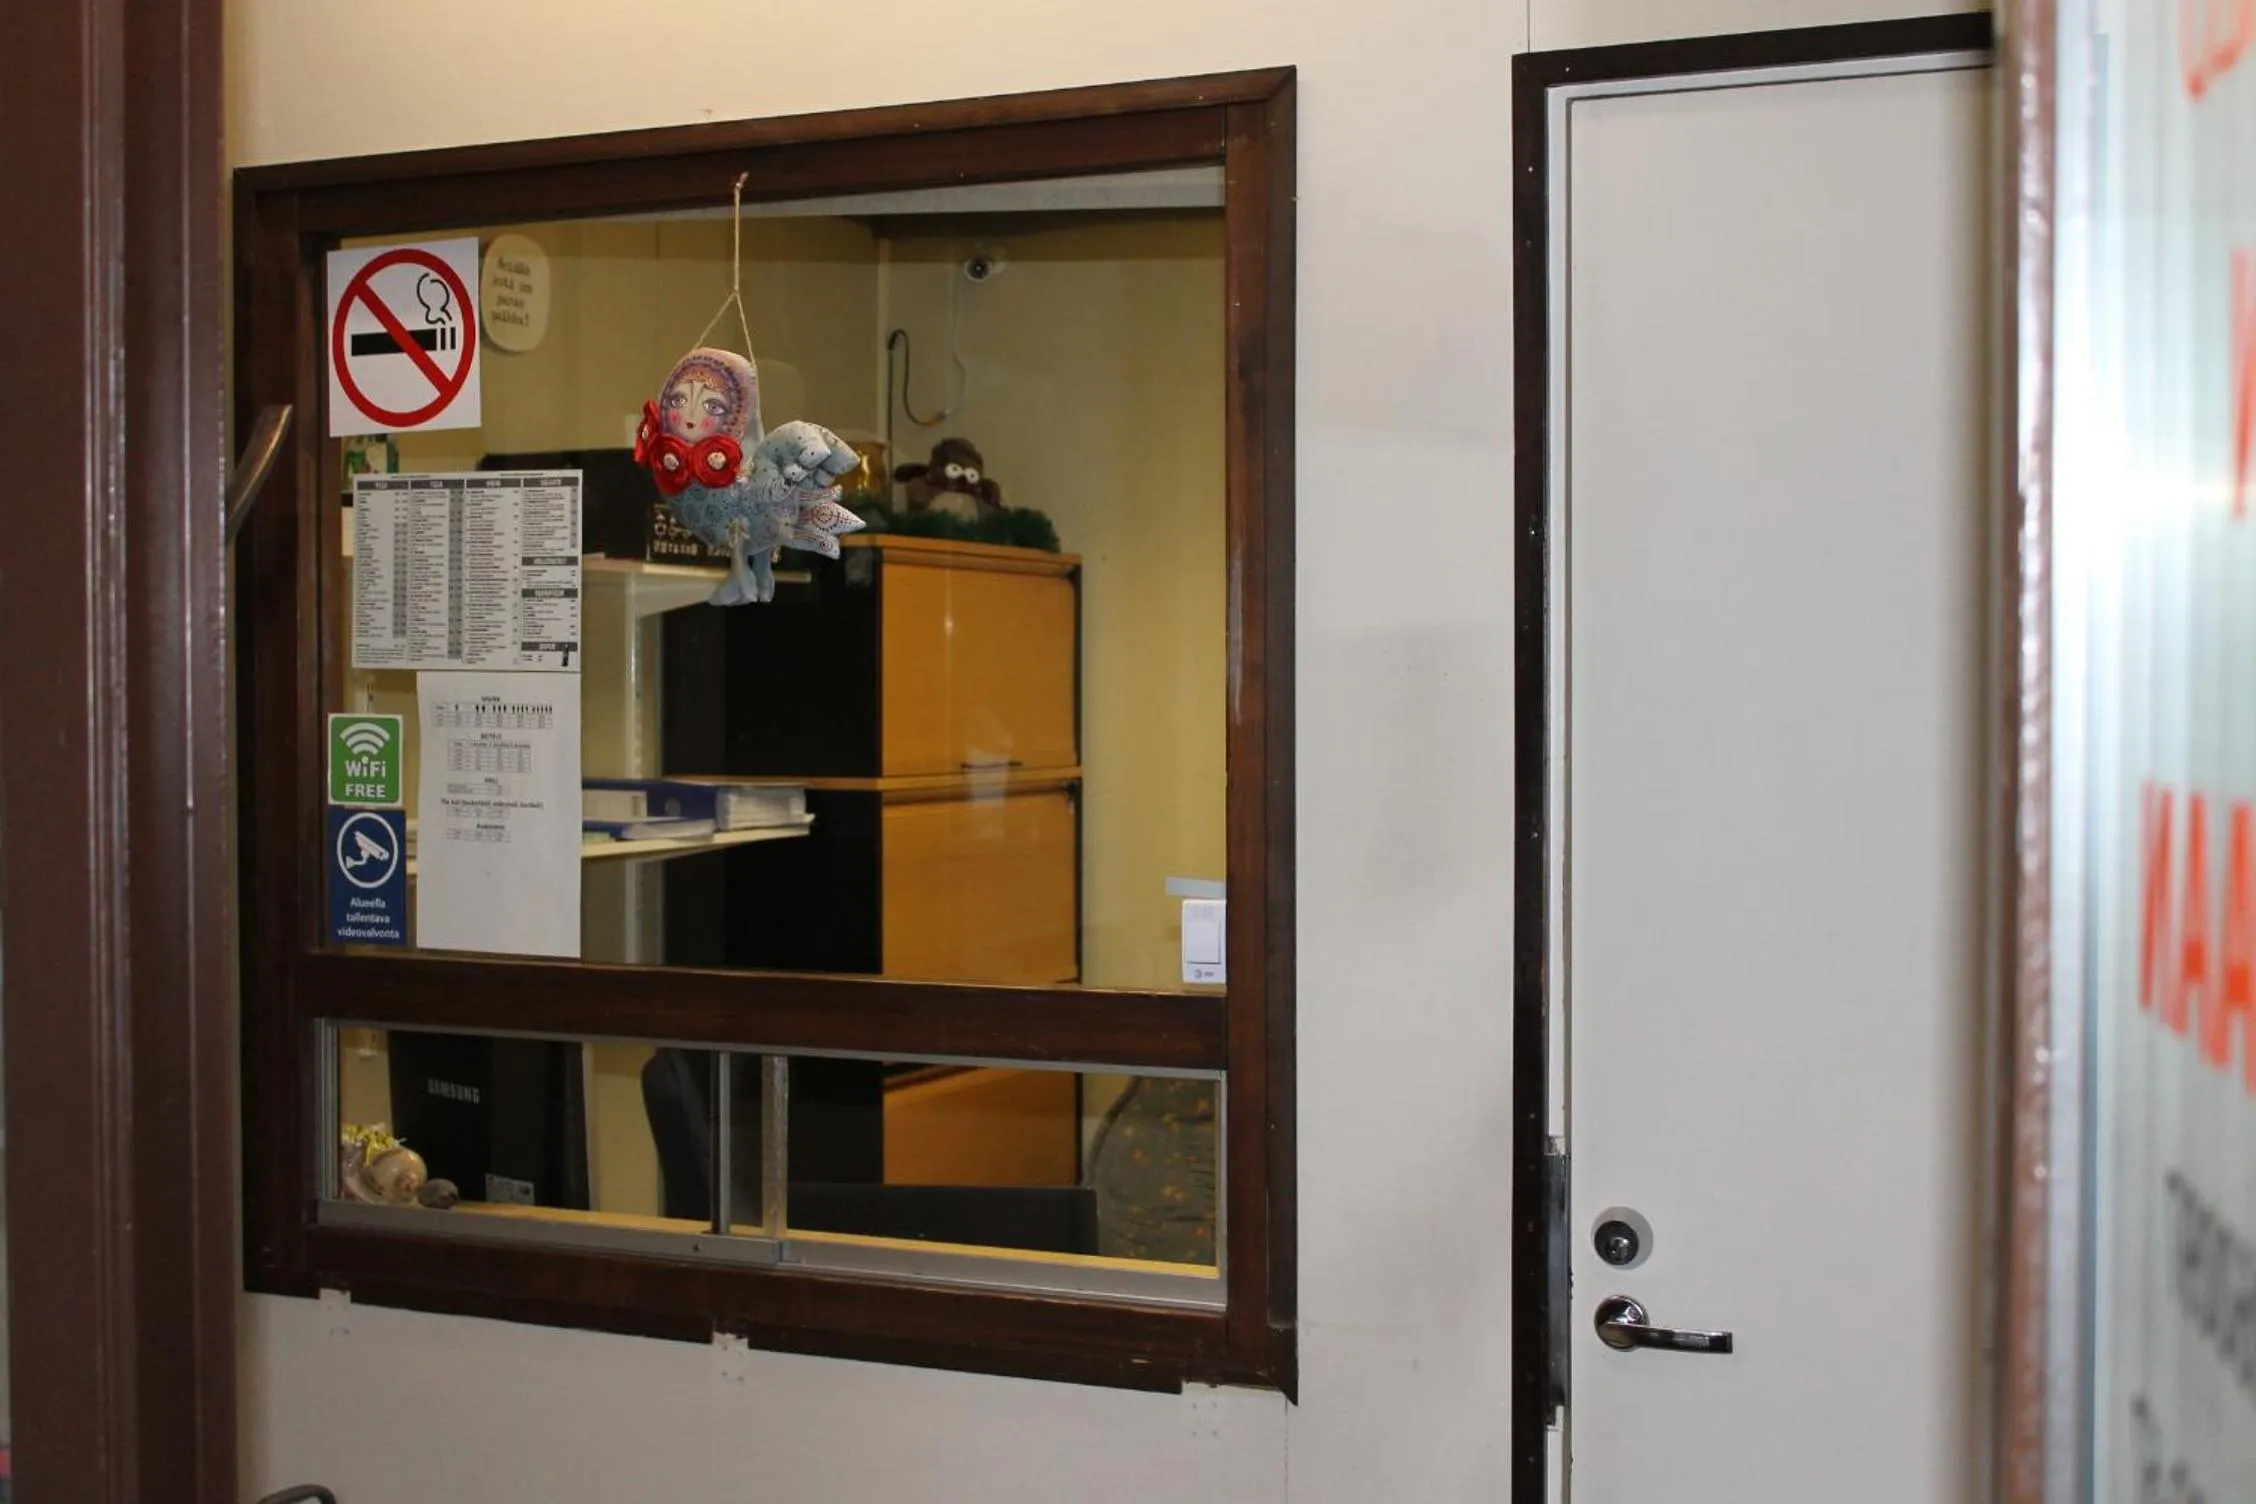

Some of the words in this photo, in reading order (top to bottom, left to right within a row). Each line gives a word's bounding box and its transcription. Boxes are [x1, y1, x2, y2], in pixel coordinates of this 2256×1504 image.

[345, 756, 386, 778] WiFi
[345, 784, 386, 799] FREE
[350, 897, 386, 909] Alueella
[346, 911, 390, 925] tallentava
[337, 926, 400, 940] videovalvonta
